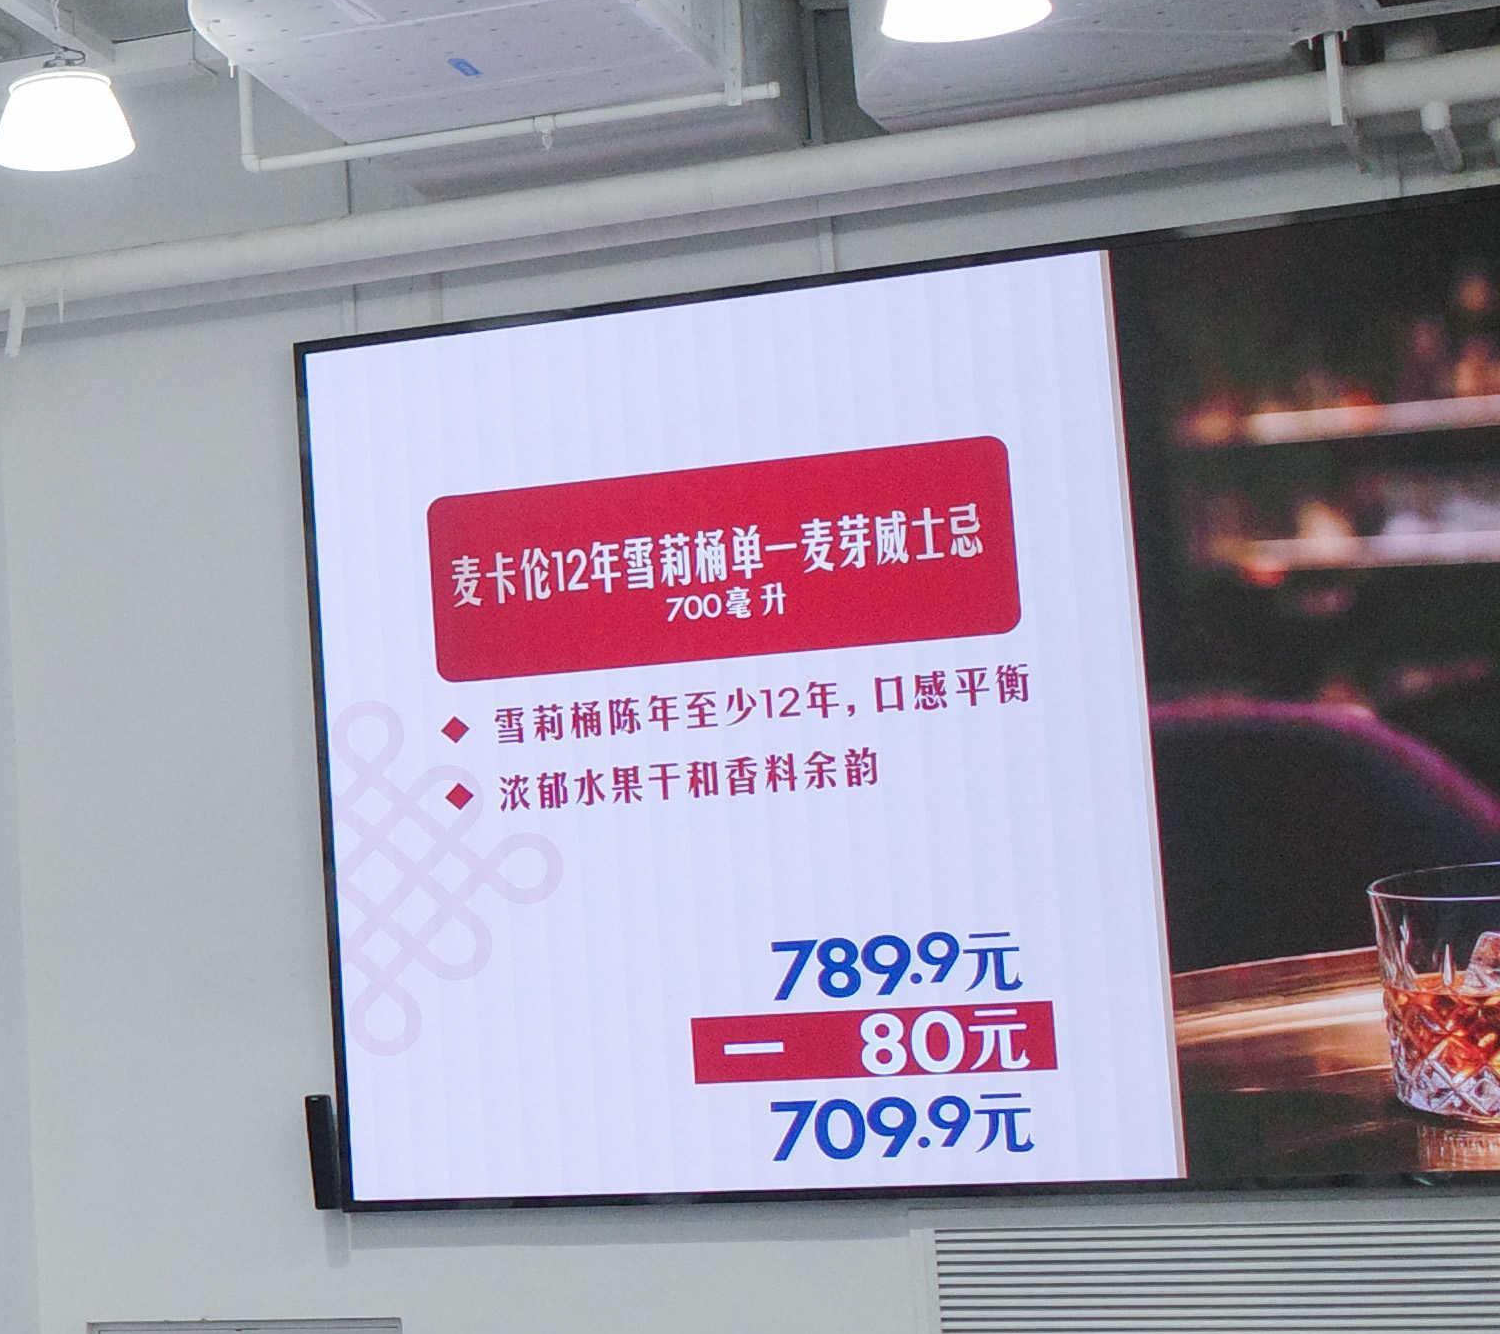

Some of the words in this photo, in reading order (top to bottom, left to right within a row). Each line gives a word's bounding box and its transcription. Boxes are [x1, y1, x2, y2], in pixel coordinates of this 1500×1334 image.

[451, 502, 986, 609] 麦卡伦12年雪莉桶单一麦芽威士忌
[499, 746, 881, 813] 浓郁水果干和香料余韵
[771, 931, 1024, 1002] 789.9元
[860, 1007, 1032, 1076] 80元
[770, 1092, 1036, 1162] 709.9元
